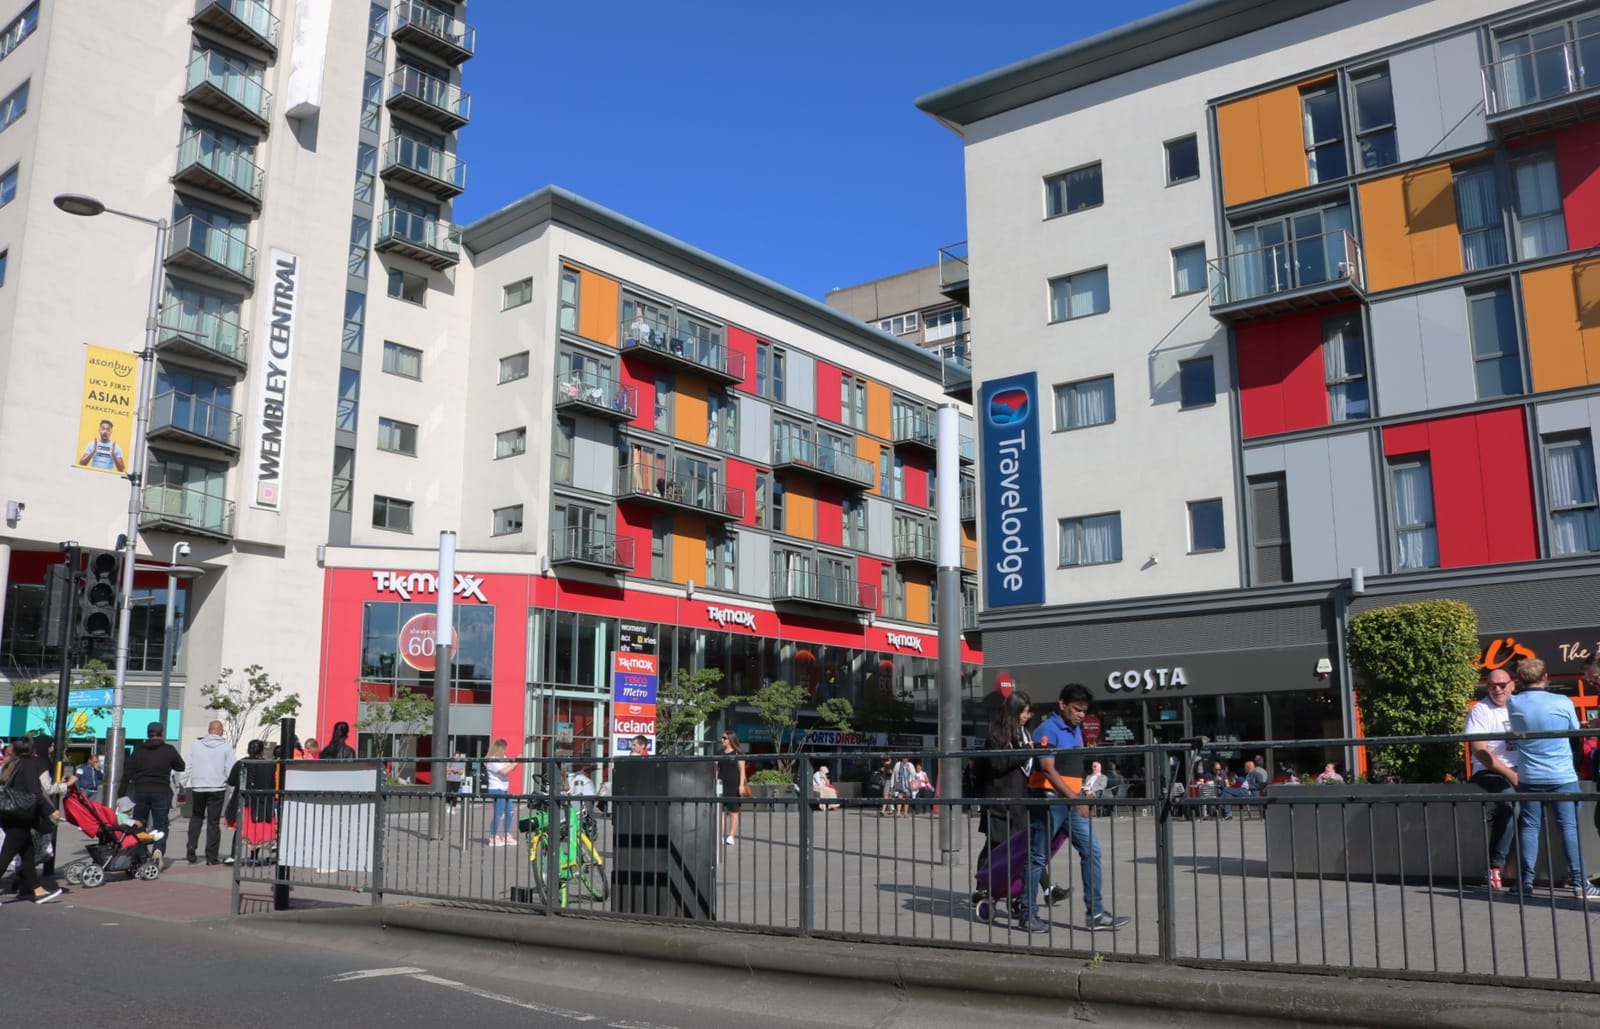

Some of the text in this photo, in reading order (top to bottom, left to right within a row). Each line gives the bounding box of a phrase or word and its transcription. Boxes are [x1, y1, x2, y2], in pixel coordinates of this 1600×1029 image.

[89, 358, 134, 377] asonbuy
[258, 256, 297, 481] WEMBLEY CENTRAL
[89, 378, 131, 391] UK'S FIRST
[88, 390, 130, 406] ASIAN
[85, 404, 130, 417] MARKETPLACE
[996, 429, 1030, 592] Travelodge
[408, 636, 437, 657] 60
[1558, 641, 1591, 662] The
[1107, 667, 1187, 690] COSTA
[623, 687, 648, 698] Metro
[614, 718, 655, 734] Iceland
[805, 731, 835, 744] PORTS
